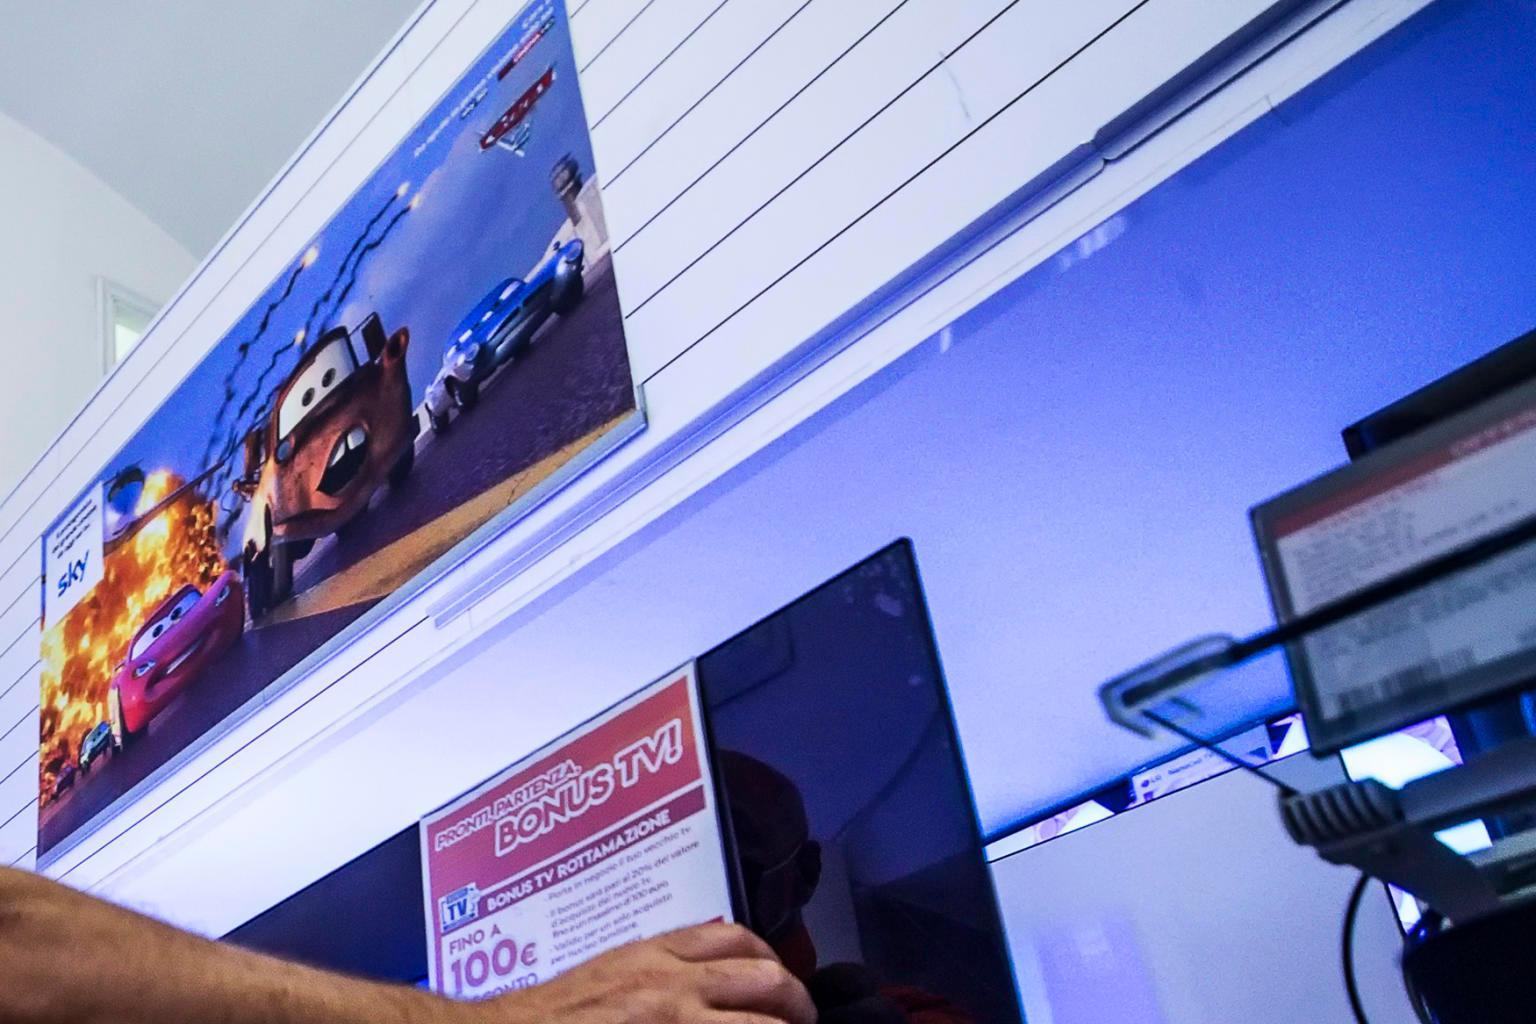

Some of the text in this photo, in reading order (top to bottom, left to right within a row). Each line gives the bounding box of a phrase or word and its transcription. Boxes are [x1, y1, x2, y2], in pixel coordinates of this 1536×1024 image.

[57, 549, 90, 598] sky
[494, 717, 683, 858] BONUS TV!
[486, 880, 534, 912] BONUS
[534, 867, 555, 889] TV
[556, 808, 672, 880] ROTTAMAZIONE
[447, 898, 468, 921] TV
[449, 924, 502, 955] FINO A
[450, 938, 538, 997] 100€
